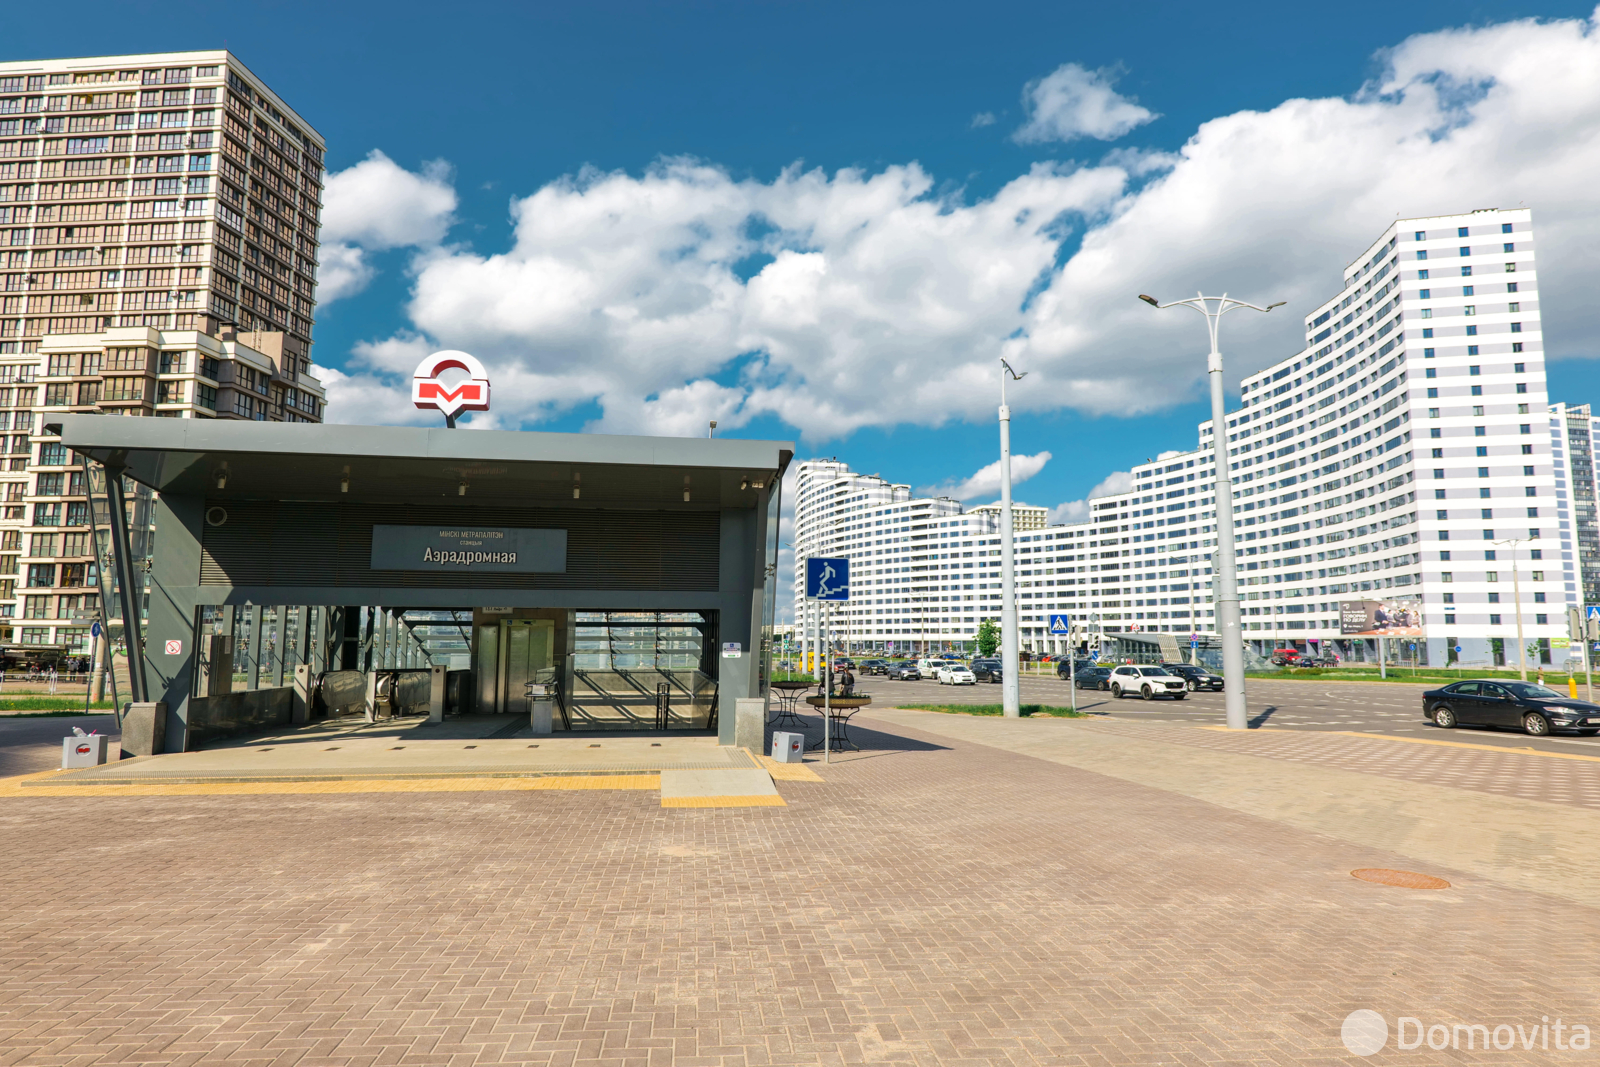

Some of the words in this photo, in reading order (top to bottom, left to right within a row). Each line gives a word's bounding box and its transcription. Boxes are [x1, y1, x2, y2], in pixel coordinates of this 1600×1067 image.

[439, 530, 460, 538] МІНСКІ
[461, 531, 504, 539] МЕТРАПАЛІТЭН
[423, 547, 517, 565] Аэрадромная
